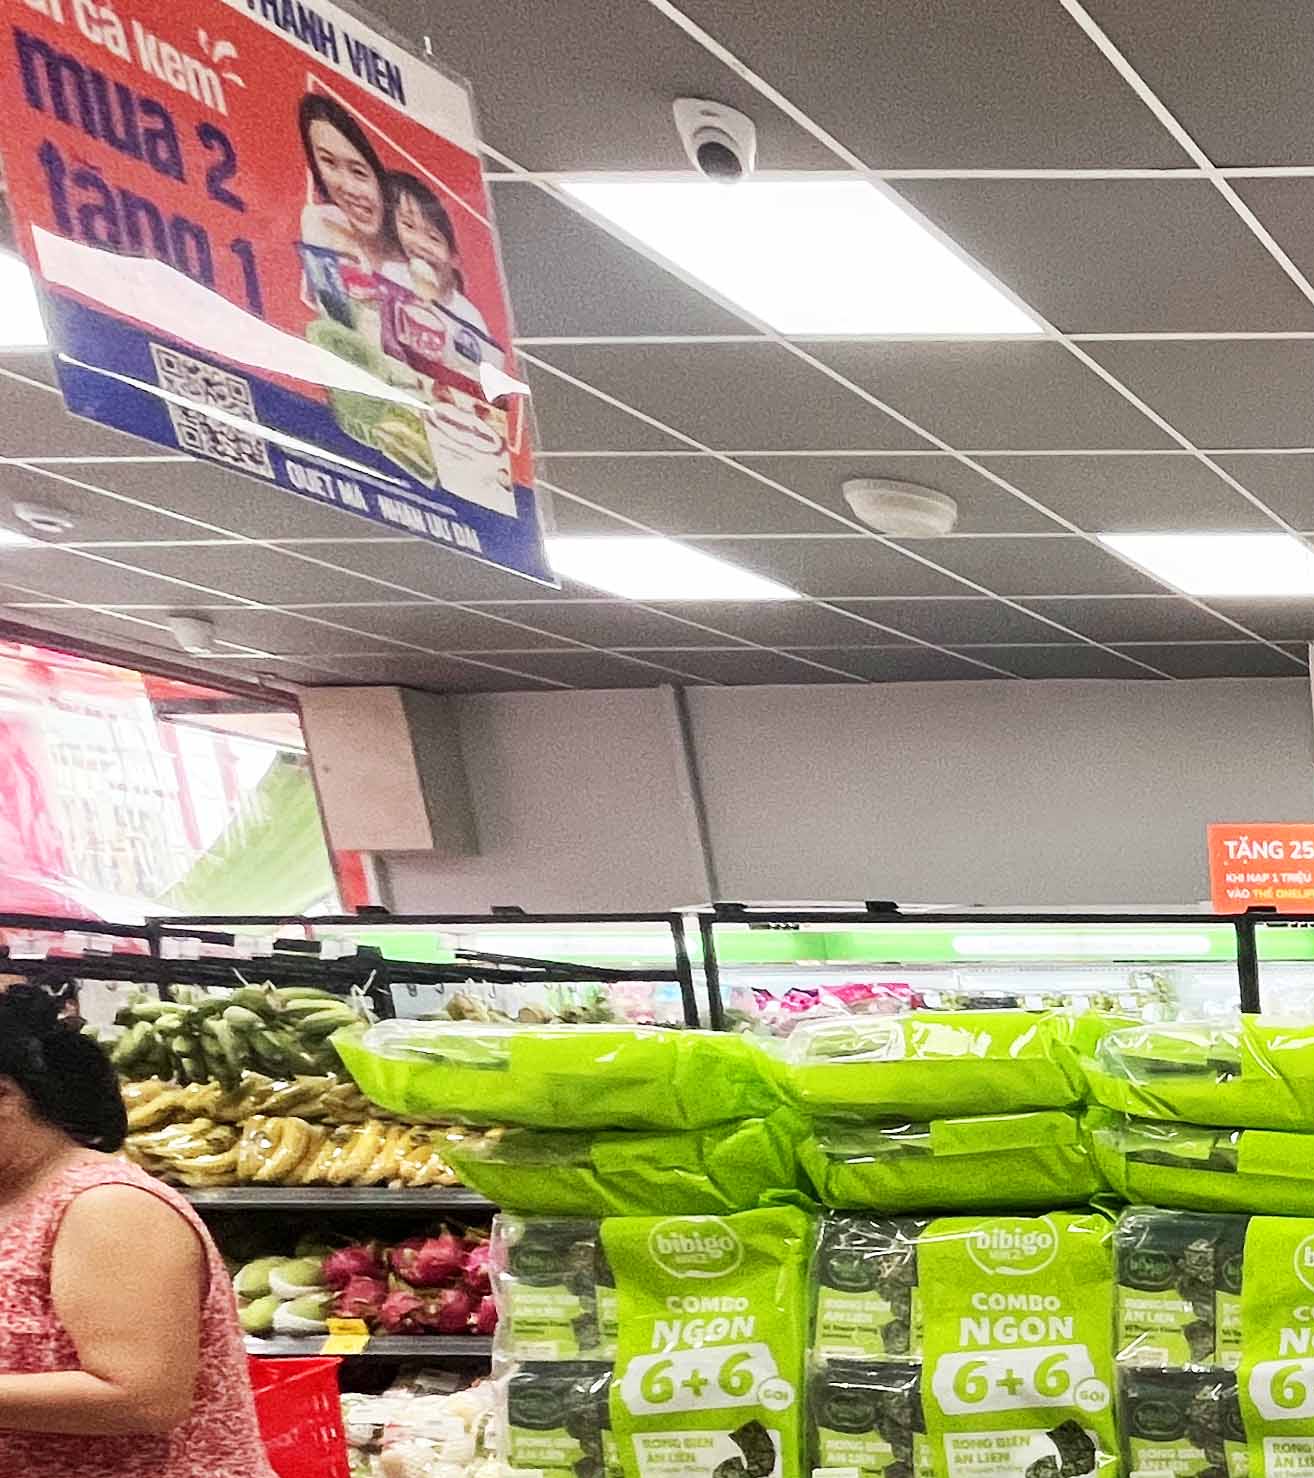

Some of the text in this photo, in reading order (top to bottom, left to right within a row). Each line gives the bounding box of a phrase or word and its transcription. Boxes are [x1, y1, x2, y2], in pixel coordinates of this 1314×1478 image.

[132, 20, 228, 117] kem
[12, 26, 245, 212] mua 2
[231, 239, 265, 318] 1
[1223, 836, 1284, 865] TẶNG
[655, 1232, 735, 1256] bibigo
[976, 1229, 1053, 1257] bibigo
[665, 1295, 749, 1314] COMBO
[971, 1292, 1061, 1312] COMBO
[651, 1315, 756, 1350] NGON
[959, 1314, 1075, 1346] NGON
